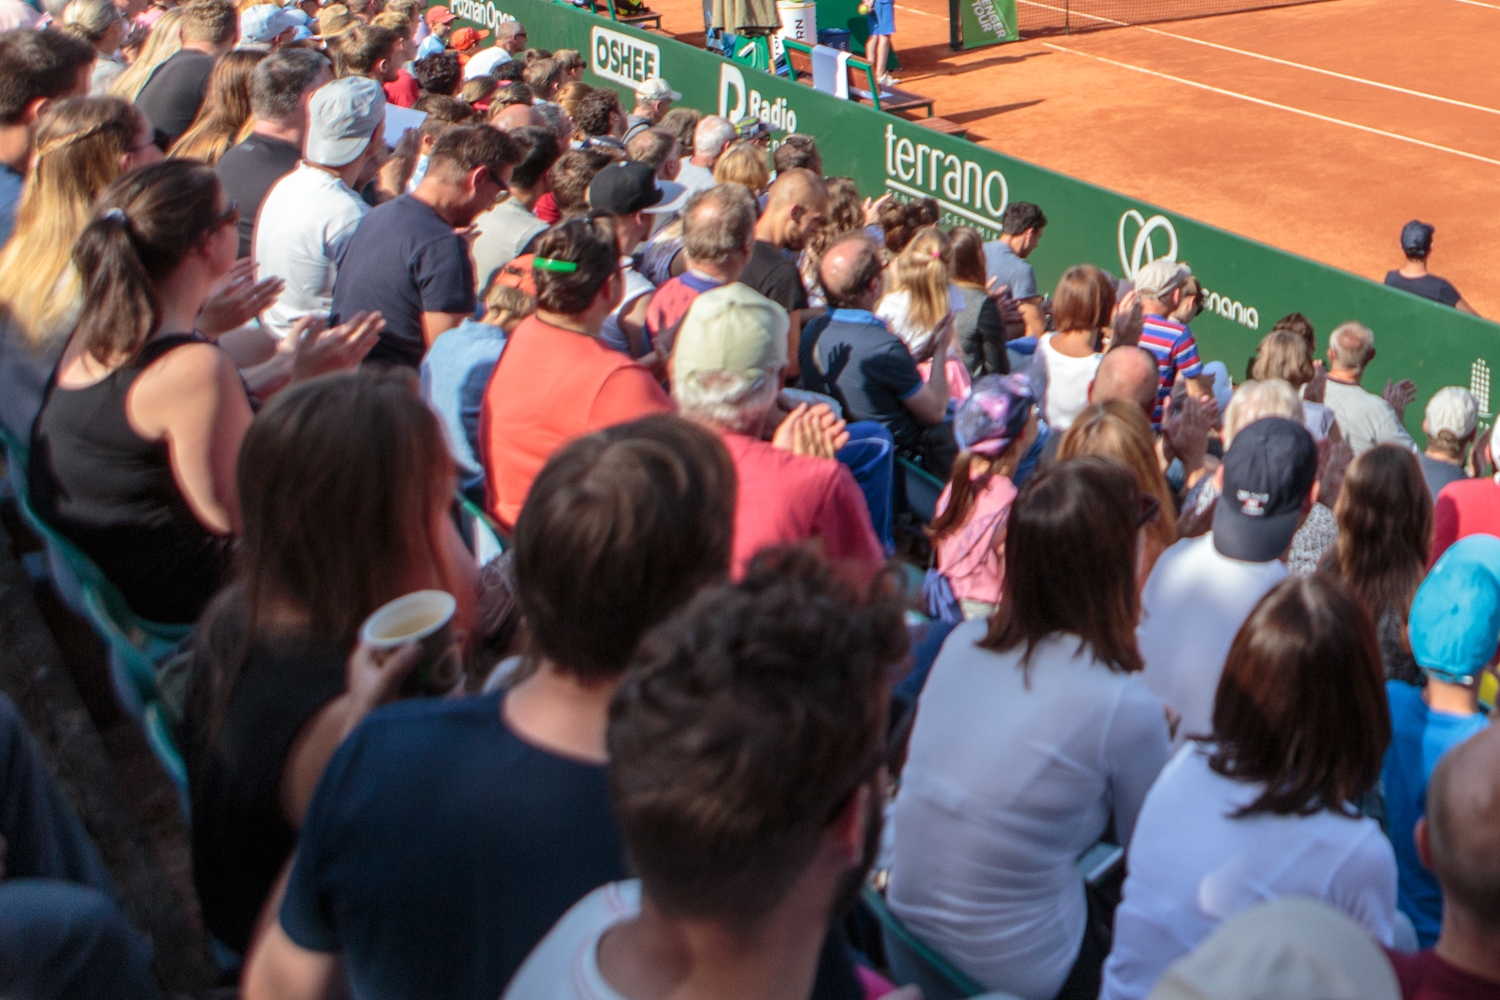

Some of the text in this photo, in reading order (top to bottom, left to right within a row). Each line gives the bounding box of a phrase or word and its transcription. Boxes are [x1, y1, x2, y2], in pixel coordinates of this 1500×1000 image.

[971, 0, 993, 33] TOUR
[596, 35, 656, 83] OSHEE
[750, 90, 797, 134] Radio
[885, 124, 1008, 217] terrano
